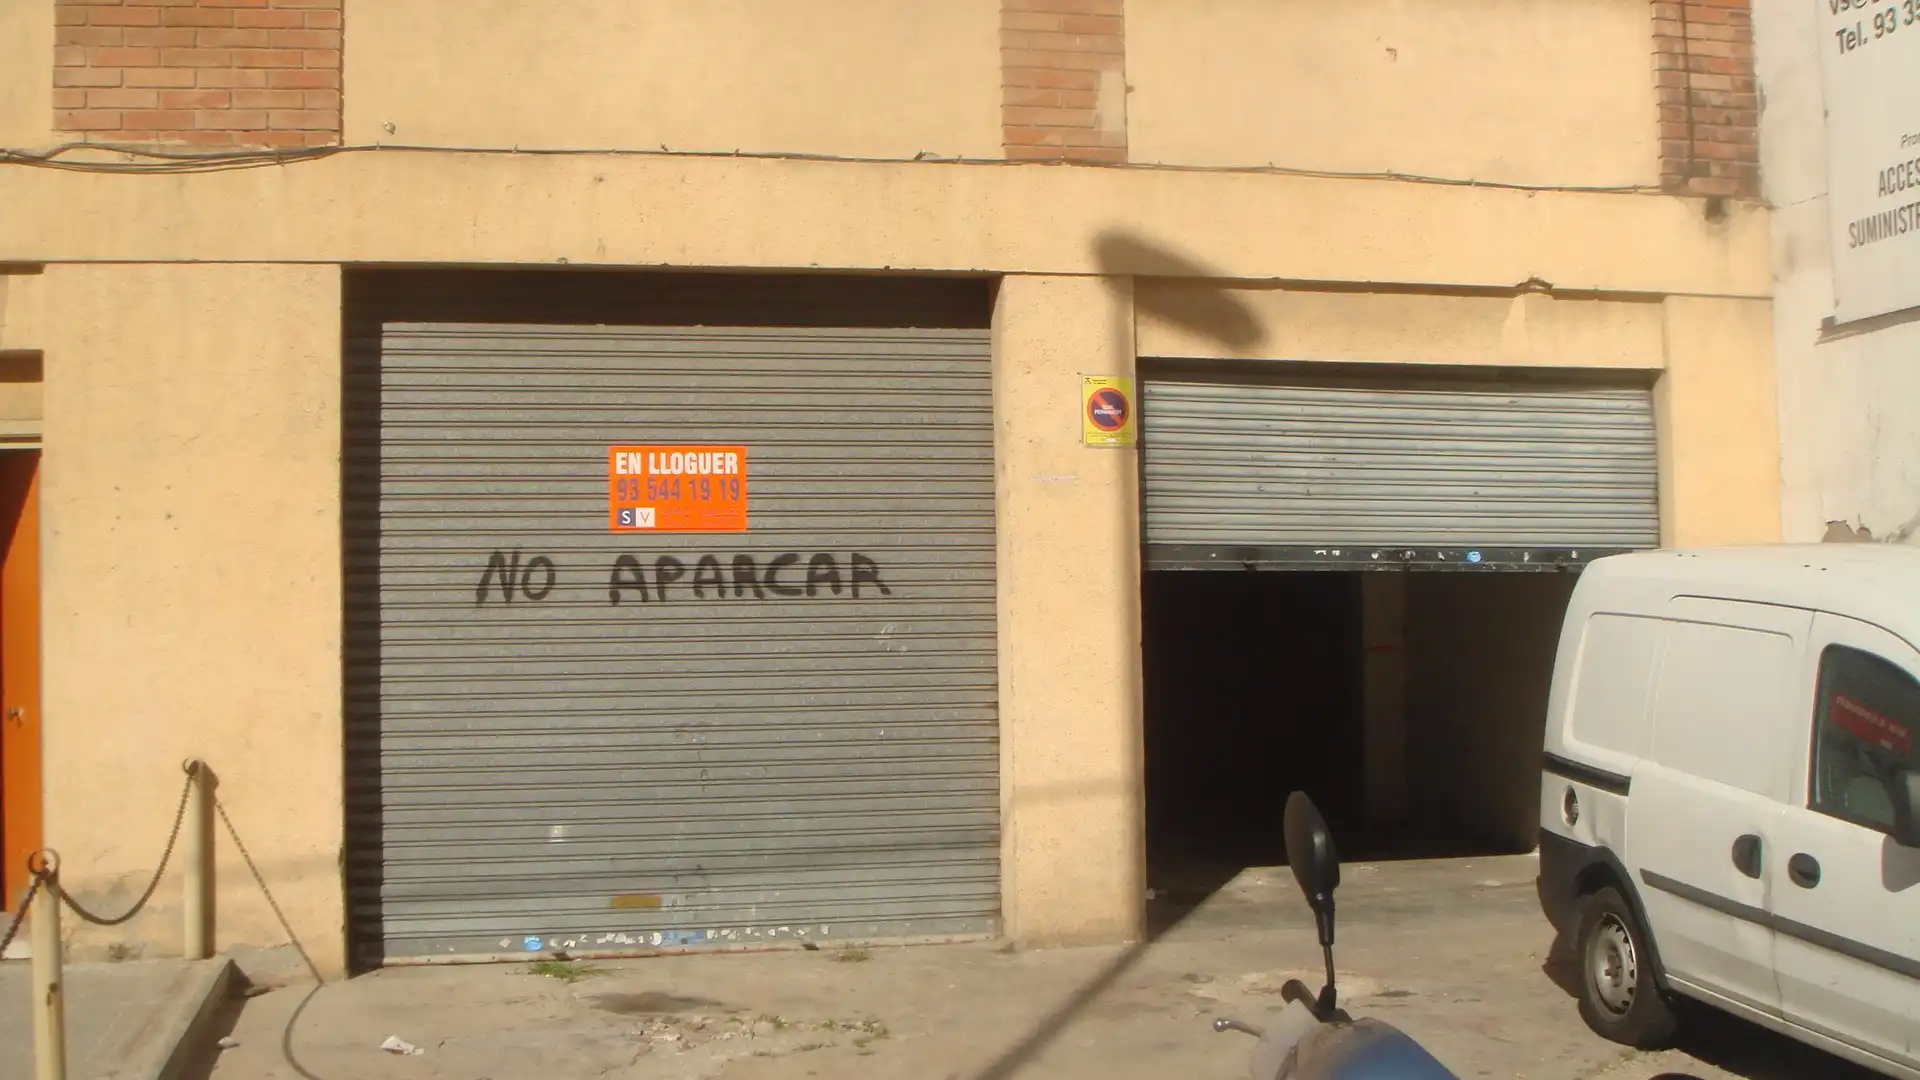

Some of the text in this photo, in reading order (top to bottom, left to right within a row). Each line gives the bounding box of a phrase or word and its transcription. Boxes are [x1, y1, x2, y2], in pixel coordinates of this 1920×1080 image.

[1836, 20, 1868, 55] Tel.
[1874, 7, 1896, 39] 93
[615, 452, 738, 474] EN LLOGUER
[617, 478, 739, 501] 93 544 19 19
[476, 550, 891, 606] NO APARCAR
